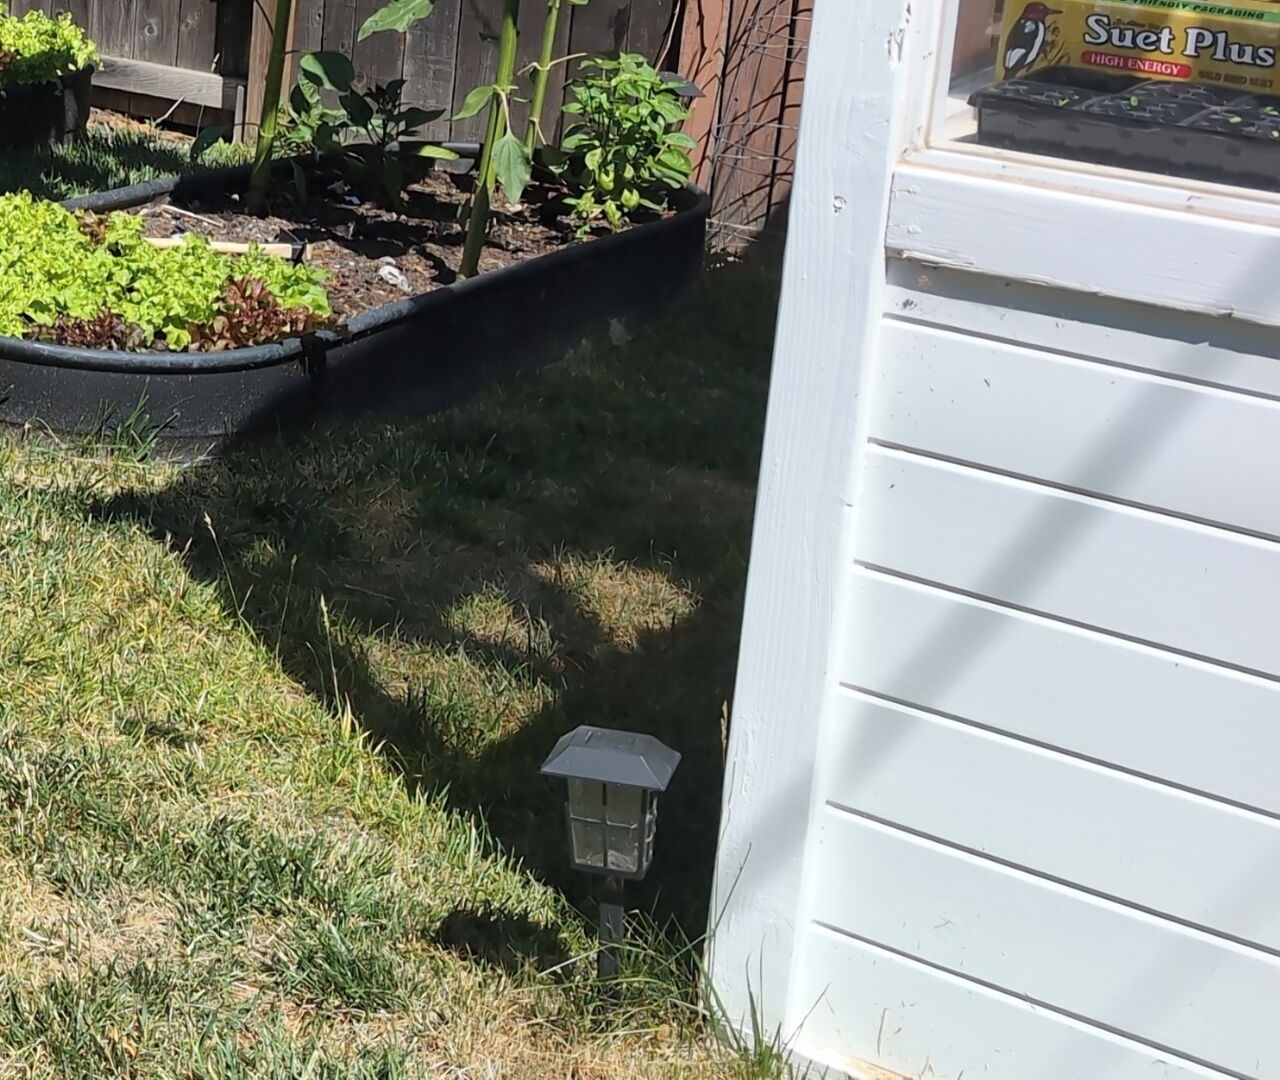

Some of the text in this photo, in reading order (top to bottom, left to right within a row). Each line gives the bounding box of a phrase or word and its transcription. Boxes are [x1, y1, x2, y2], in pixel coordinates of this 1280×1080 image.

[1193, 4, 1265, 20] PACKAGING
[1083, 14, 1276, 68] Suet Plus
[1091, 53, 1181, 76] HIGH ENERGY
